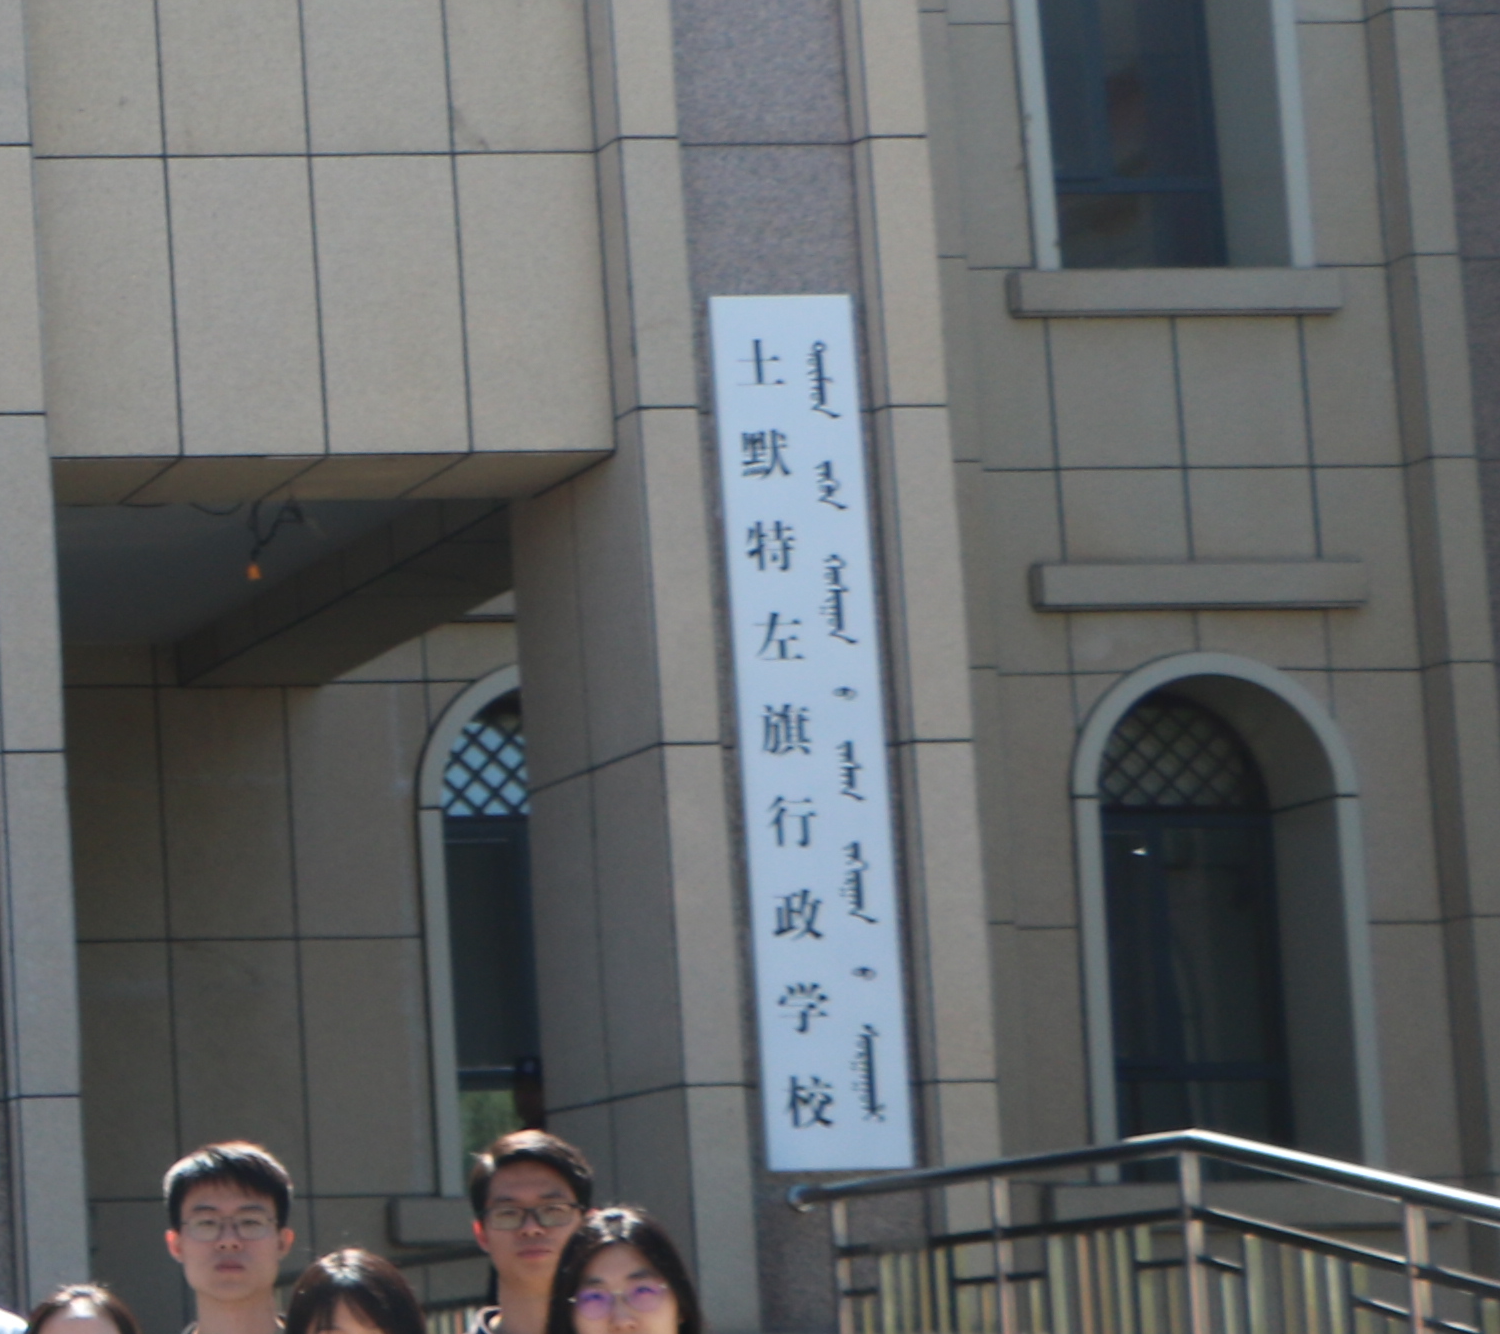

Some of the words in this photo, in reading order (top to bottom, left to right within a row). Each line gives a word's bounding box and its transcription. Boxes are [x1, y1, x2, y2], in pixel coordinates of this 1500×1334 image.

[737, 338, 834, 1130] 土默特左旗行政学校
